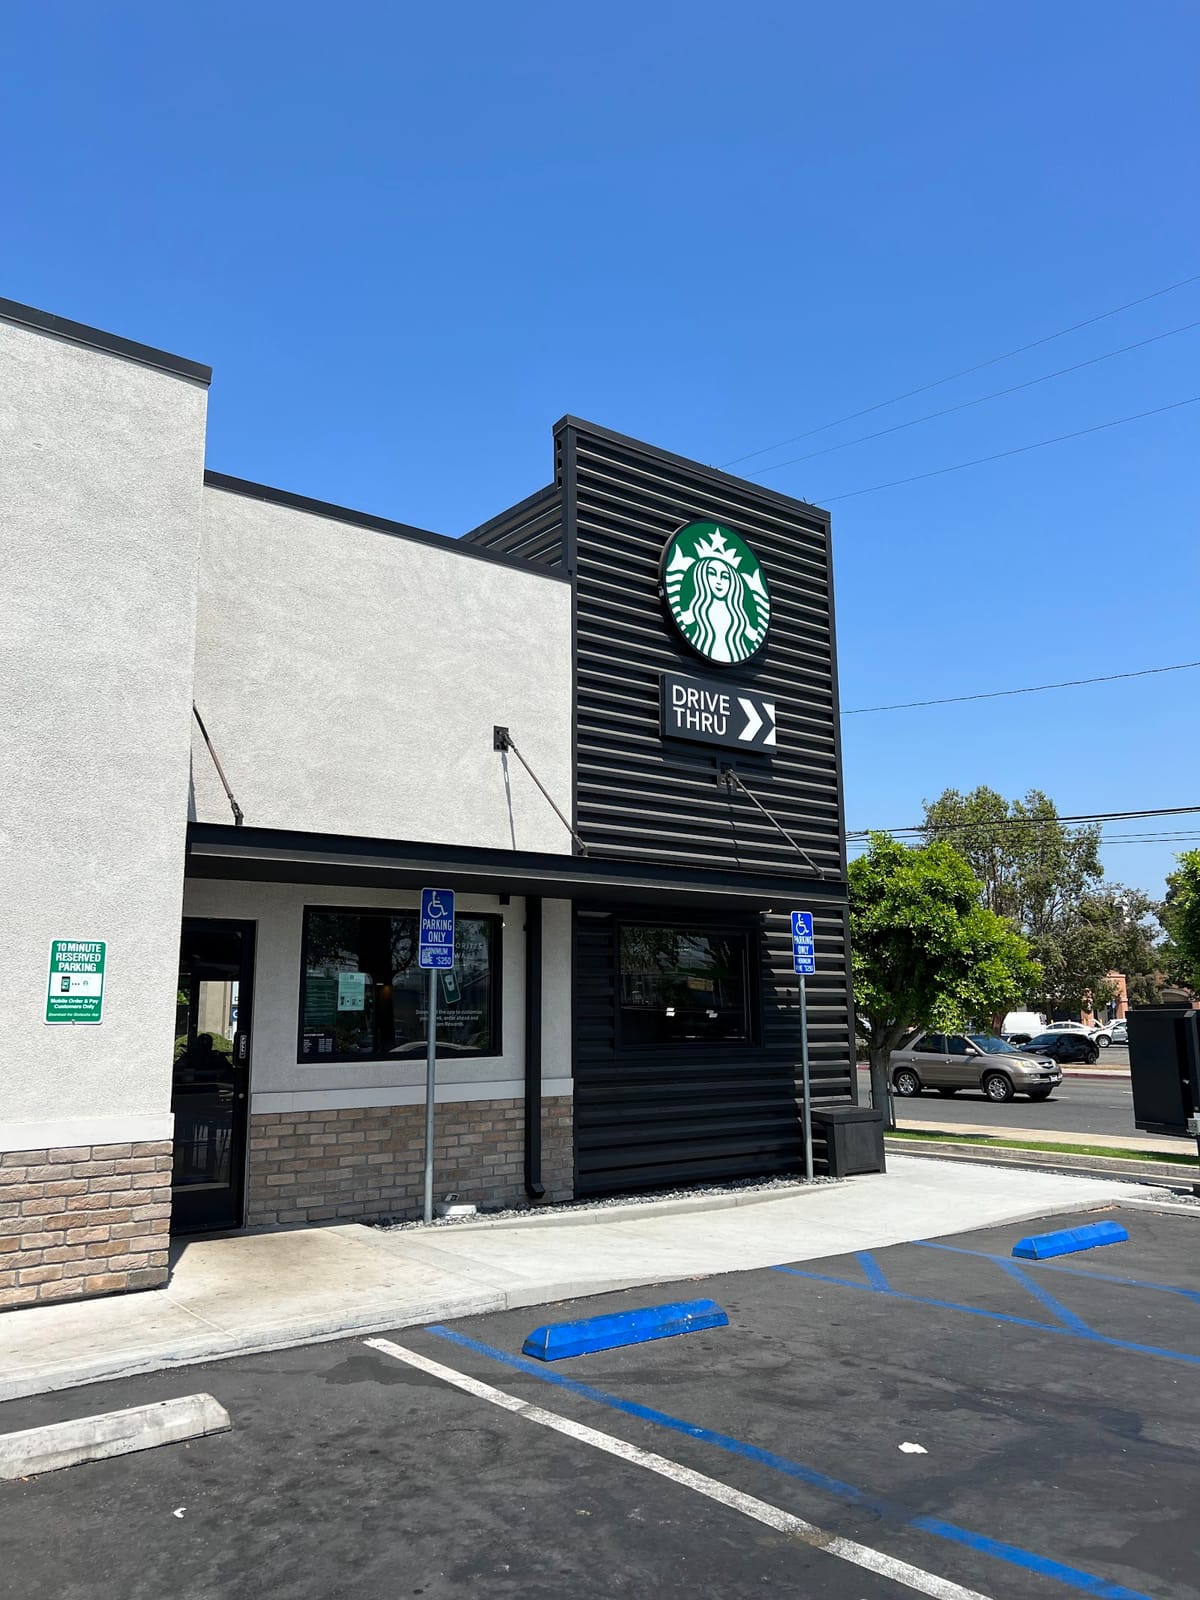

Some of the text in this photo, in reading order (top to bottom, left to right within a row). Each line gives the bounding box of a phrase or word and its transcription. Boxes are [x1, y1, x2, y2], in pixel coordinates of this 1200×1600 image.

[672, 684, 731, 715] DRIVE
[673, 706, 726, 735] THRU
[422, 919, 452, 931] PARKING
[428, 931, 446, 943] ONLY
[57, 943, 102, 953] 10 MINUTE
[56, 953, 101, 962] RESERVED
[58, 962, 97, 972] PARKING
